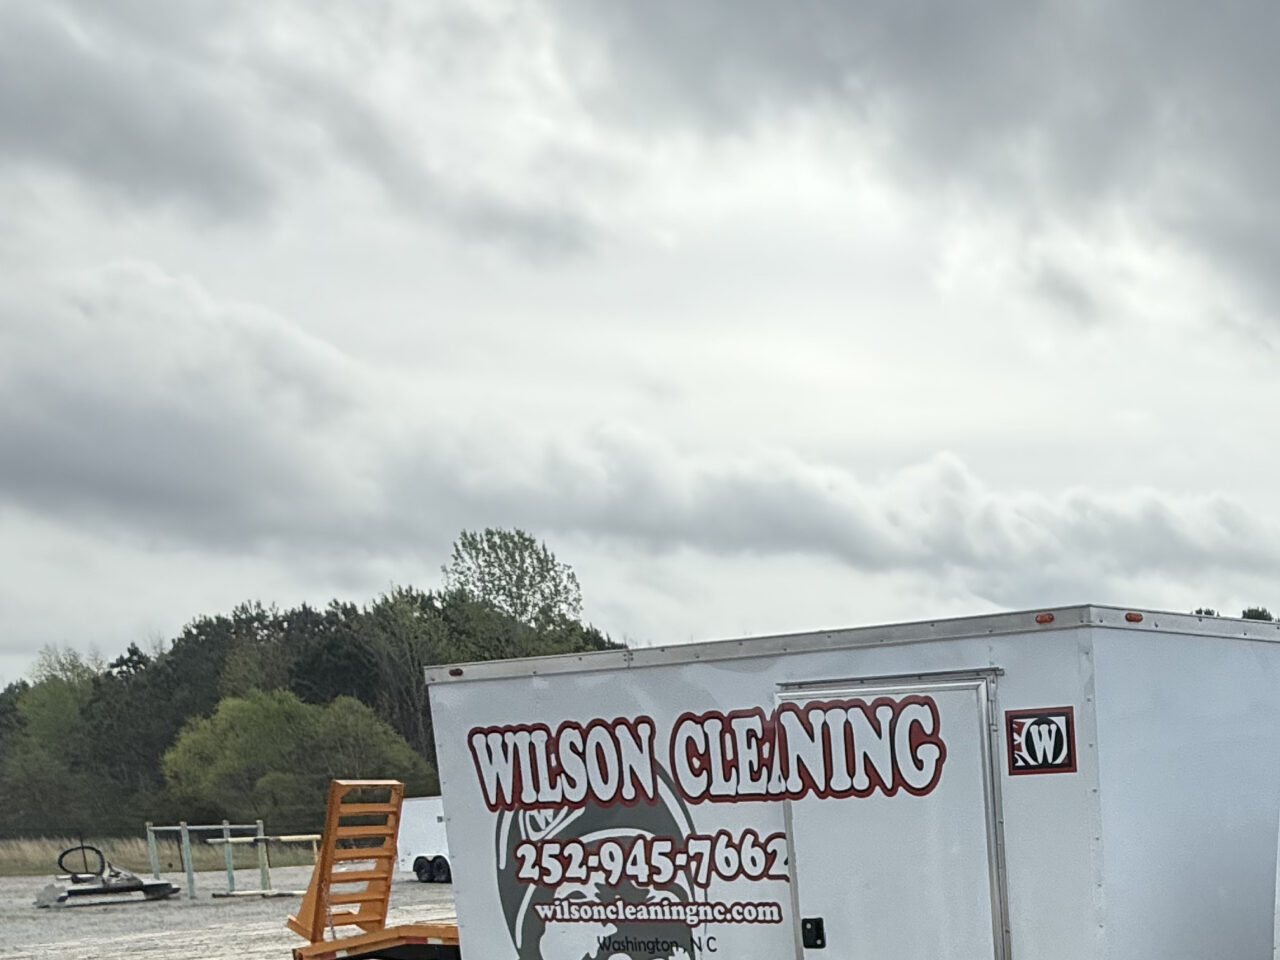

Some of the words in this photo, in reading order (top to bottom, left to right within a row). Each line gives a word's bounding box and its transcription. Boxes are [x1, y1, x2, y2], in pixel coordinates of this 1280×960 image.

[468, 715, 656, 812] WILSON
[516, 829, 791, 888] 252-945-7662
[533, 899, 783, 927] wilsoncleaningnc.com
